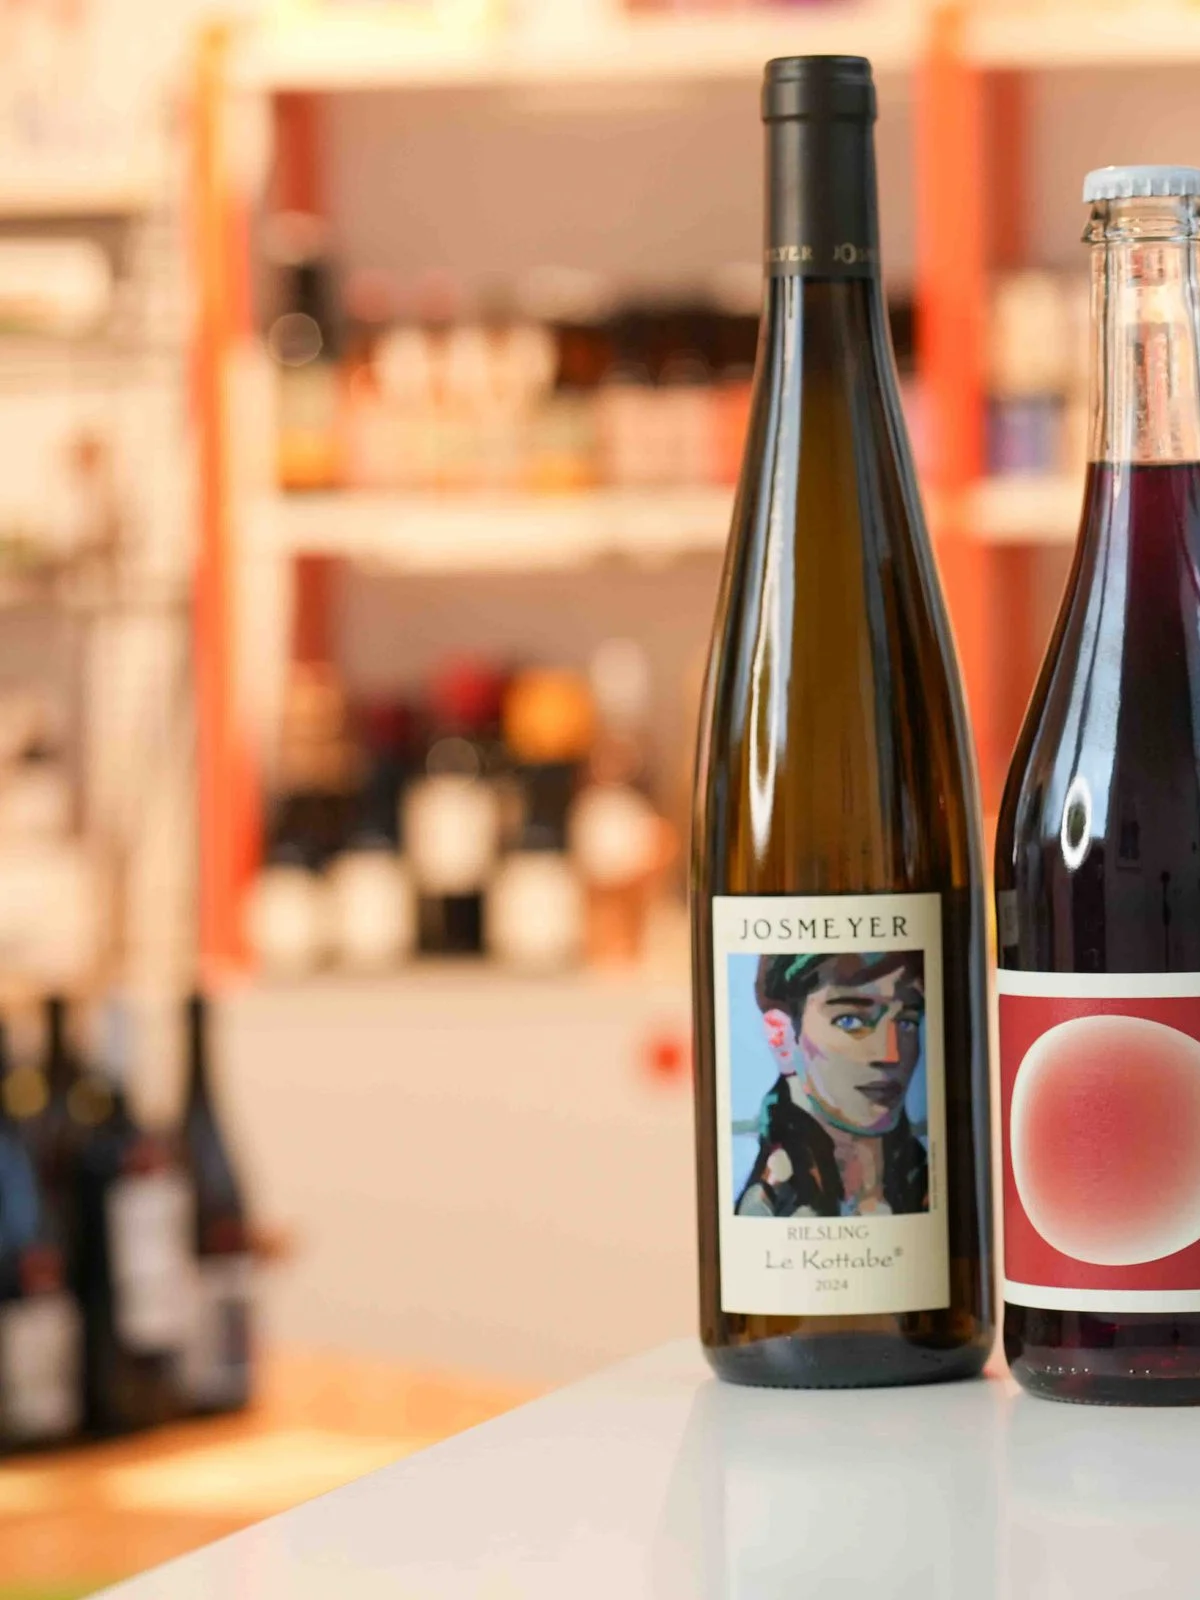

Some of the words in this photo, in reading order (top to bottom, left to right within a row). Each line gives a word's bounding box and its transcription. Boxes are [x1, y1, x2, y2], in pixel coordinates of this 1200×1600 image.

[740, 915, 908, 941] JOSMEYER
[786, 1224, 870, 1241] RIESLING
[765, 1250, 793, 1270] Le
[815, 1279, 849, 1292] 2024
